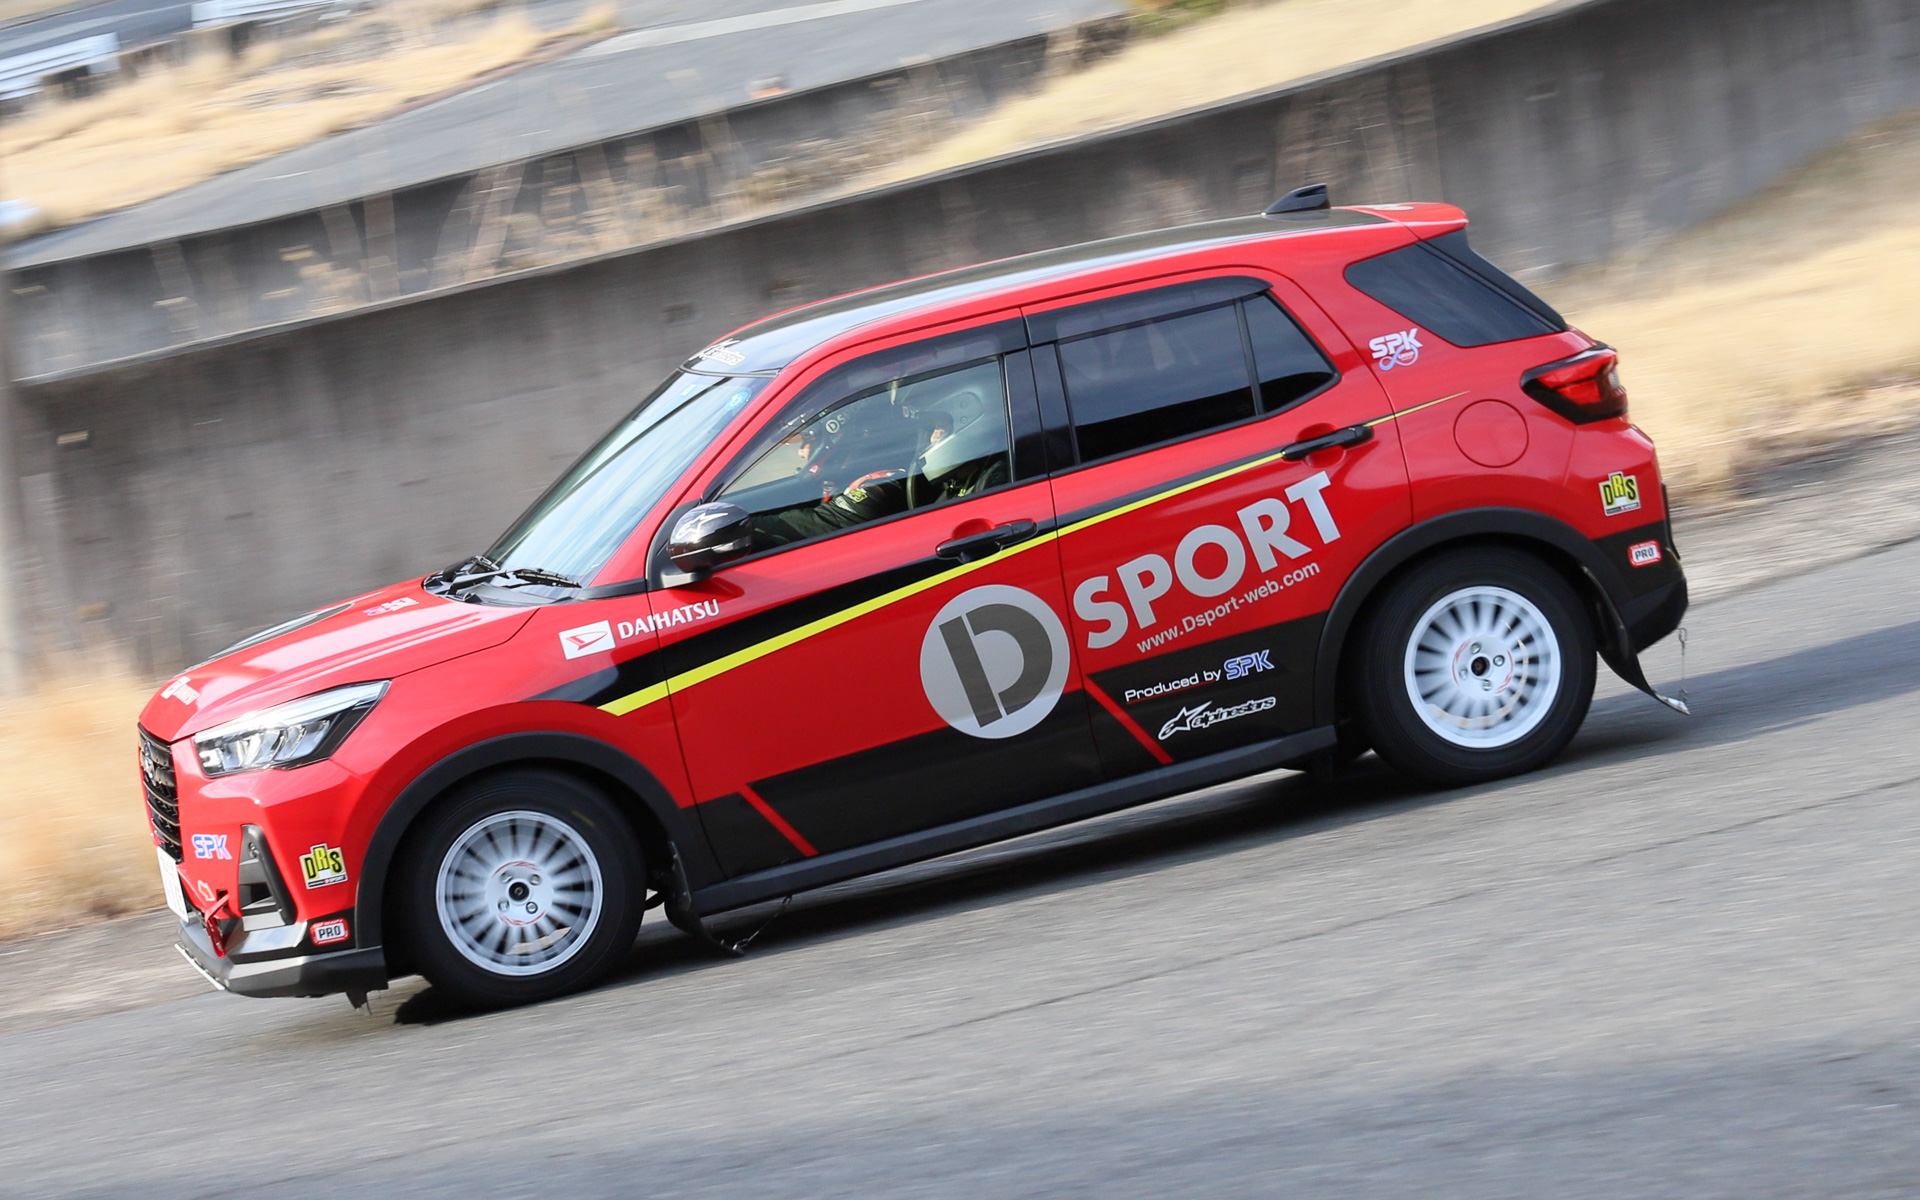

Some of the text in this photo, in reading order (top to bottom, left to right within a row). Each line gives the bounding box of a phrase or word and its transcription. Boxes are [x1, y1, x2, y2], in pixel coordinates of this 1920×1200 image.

[1368, 328, 1423, 359] SPK
[1602, 473, 1637, 506] DRS
[1634, 547, 1655, 560] PRO
[617, 598, 720, 639] DAIHATSU
[1137, 561, 1320, 653] www.Dsport-web.com
[1125, 649, 1275, 702] Produced by SPK
[191, 834, 233, 860] SPK
[303, 845, 343, 880] DRS
[318, 925, 341, 940] PRO
